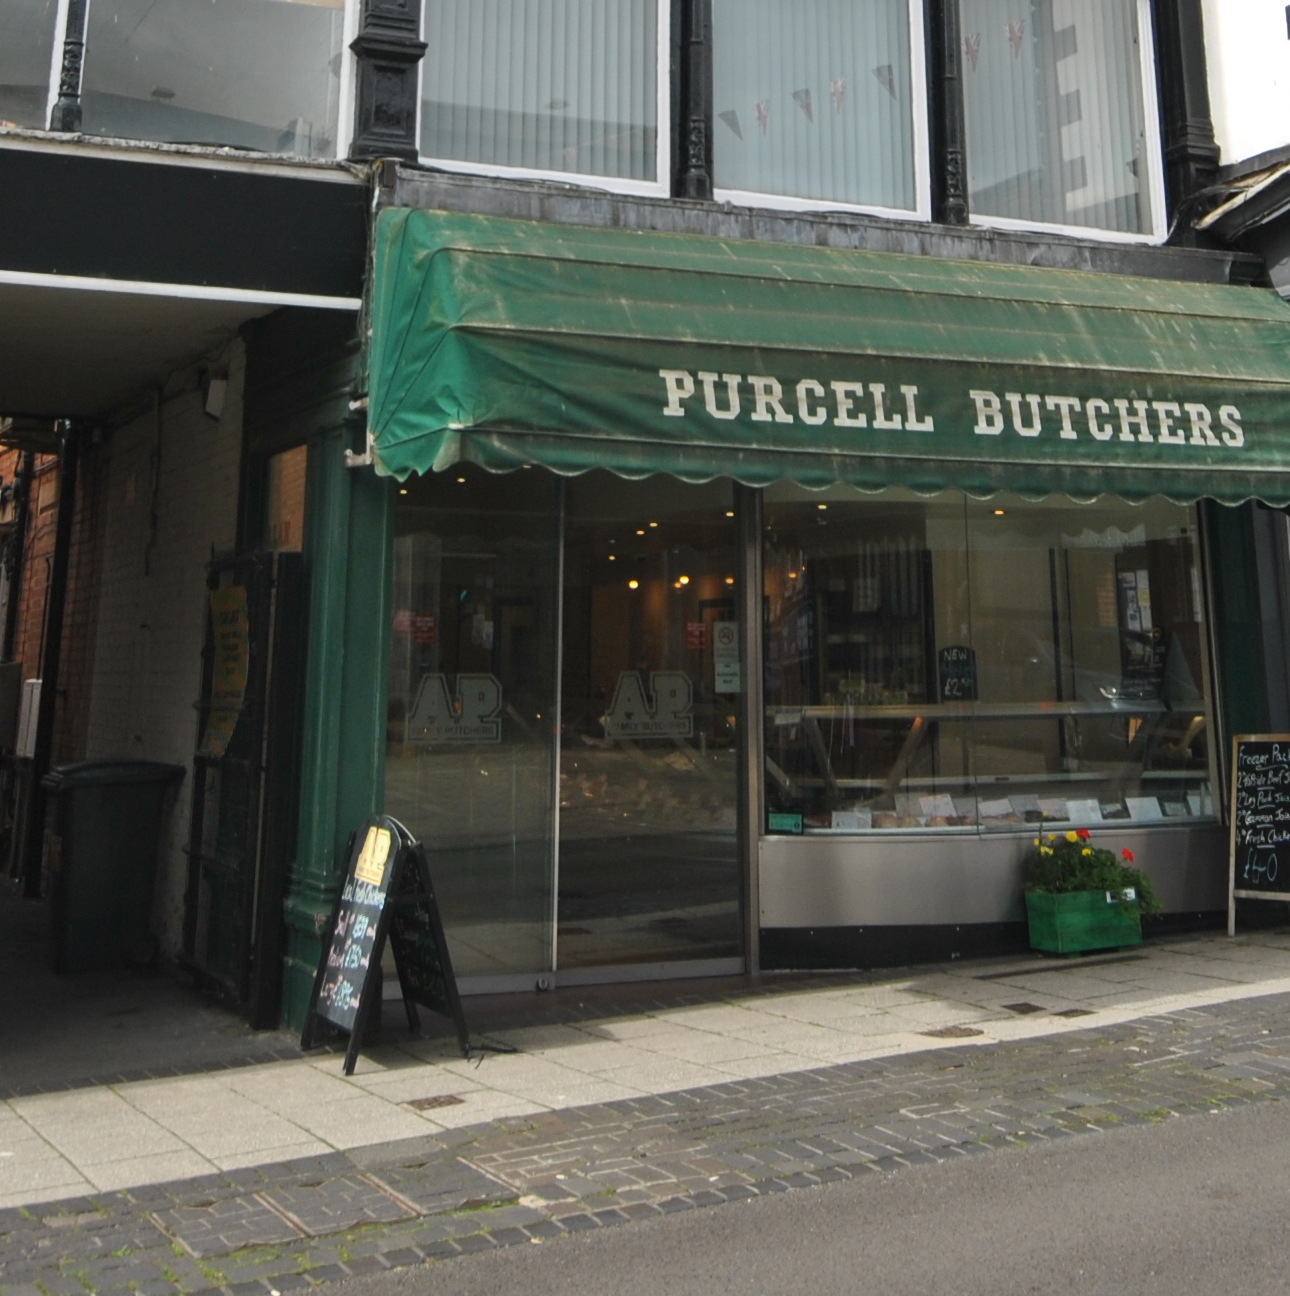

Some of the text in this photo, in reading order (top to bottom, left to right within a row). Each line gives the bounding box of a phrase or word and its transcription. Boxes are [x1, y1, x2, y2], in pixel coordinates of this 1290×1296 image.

[657, 368, 1245, 448] PURCELL BUTCHERS
[943, 647, 968, 662] NEW
[1238, 744, 1269, 766] Freezer
